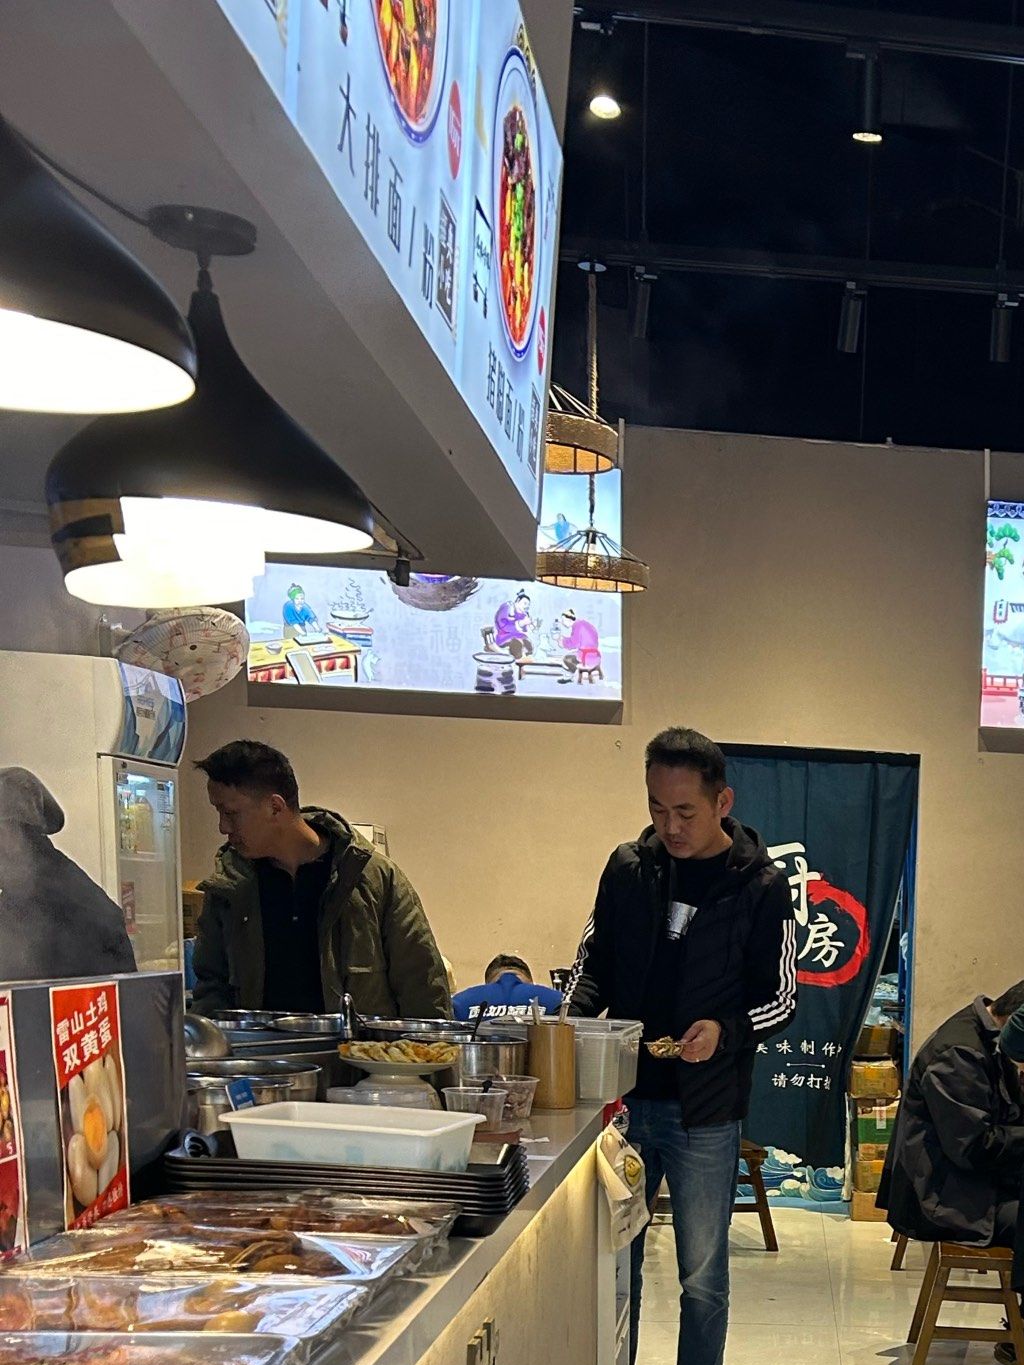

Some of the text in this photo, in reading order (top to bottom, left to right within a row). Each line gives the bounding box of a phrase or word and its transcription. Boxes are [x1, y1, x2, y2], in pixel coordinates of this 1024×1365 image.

[337, 72, 435, 310] 大排面/粉
[56, 990, 108, 1046] 雷山土鸡
[62, 1016, 112, 1074] 双黄蛋
